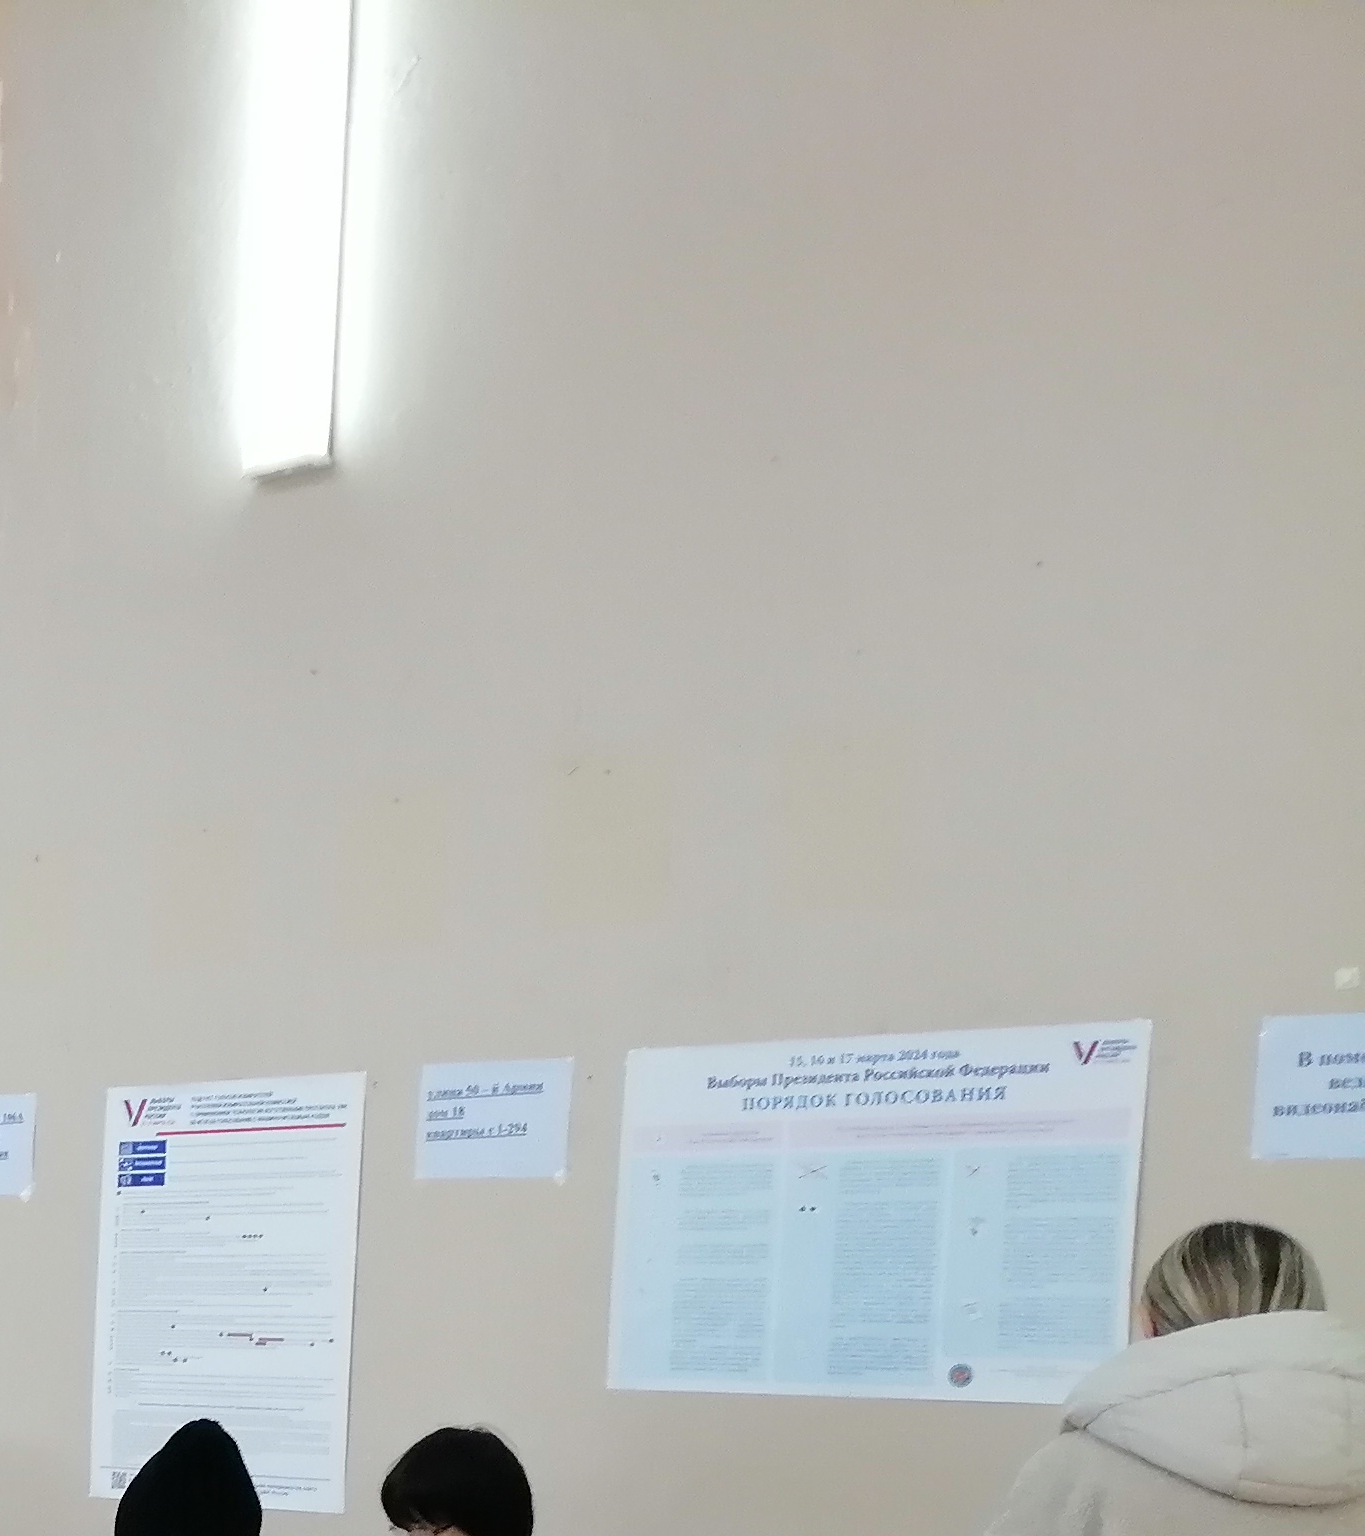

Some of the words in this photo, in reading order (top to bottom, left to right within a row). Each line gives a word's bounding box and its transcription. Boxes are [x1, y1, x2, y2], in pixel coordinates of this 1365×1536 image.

[897, 1049, 928, 1061] 2024
[1297, 1051, 1314, 1067] В
[707, 1075, 767, 1090] Выборы
[771, 1072, 859, 1089] Президента
[864, 1064, 955, 1082] Российской
[959, 1062, 1051, 1080] Федерации
[742, 1092, 837, 1111] ПОРЯДОК
[845, 1085, 1007, 1107] ГОЛОСОВАНИЯ
